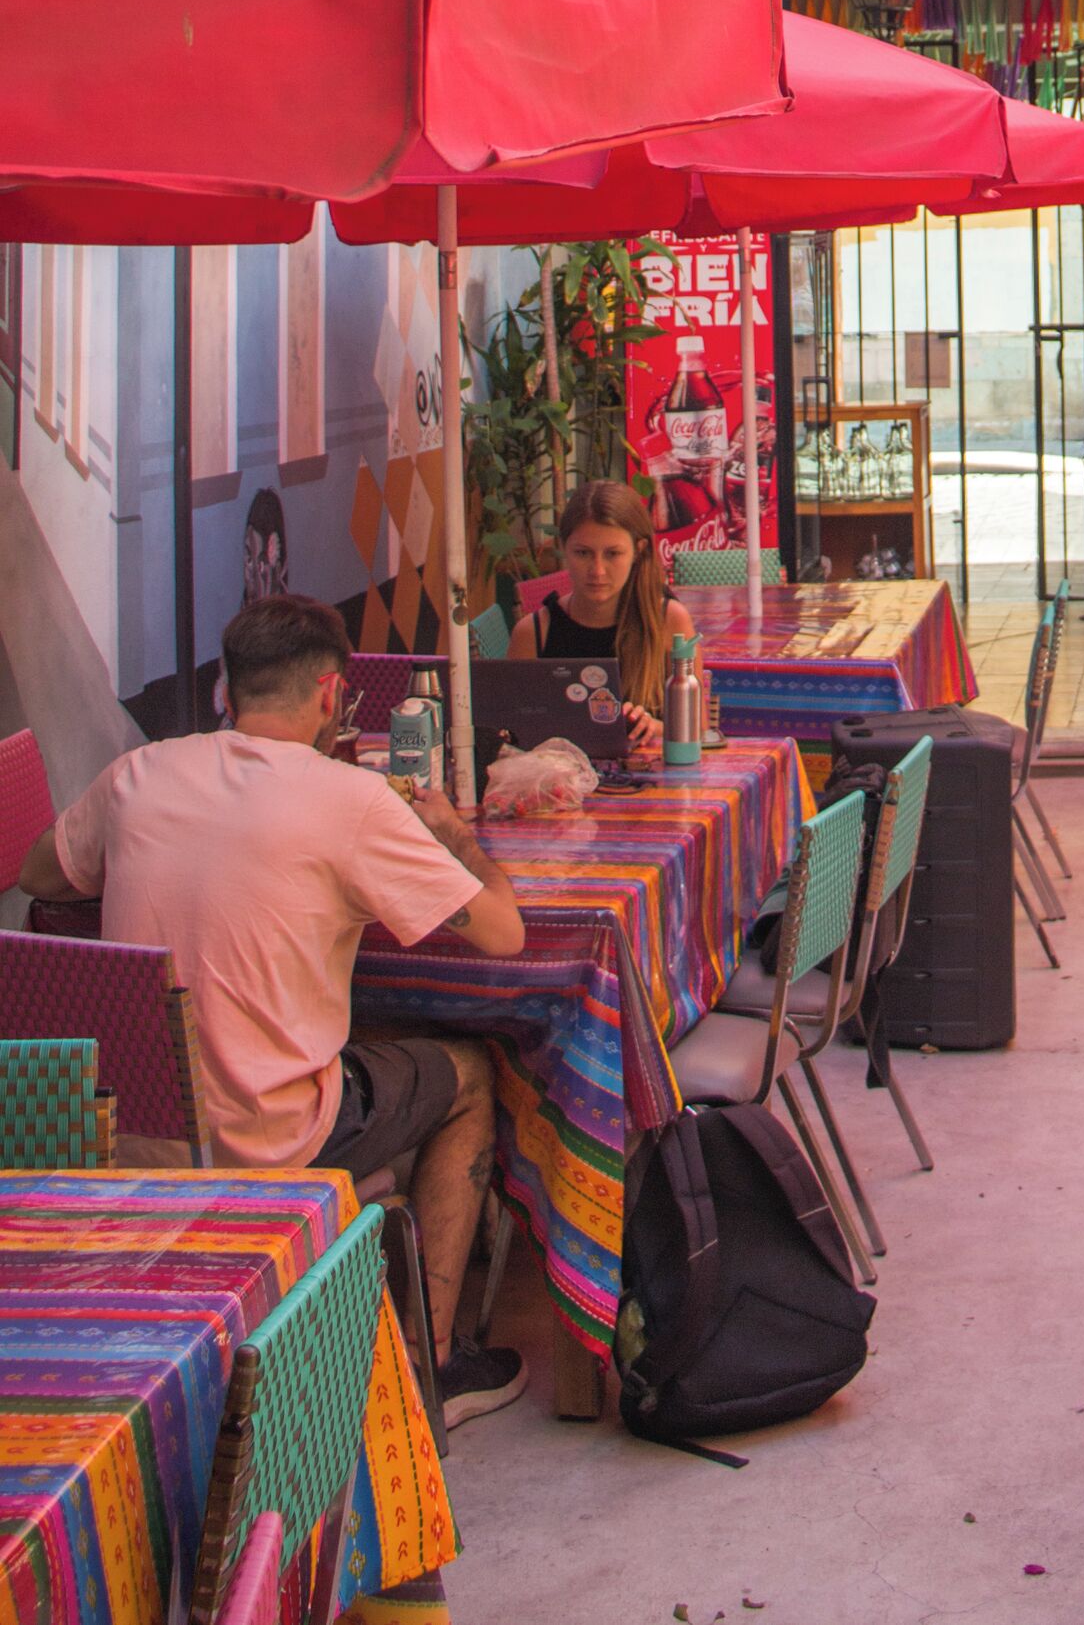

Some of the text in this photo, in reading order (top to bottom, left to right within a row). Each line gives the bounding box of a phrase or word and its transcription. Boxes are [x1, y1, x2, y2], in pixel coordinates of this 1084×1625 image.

[699, 244, 707, 252] Y
[641, 254, 768, 291] BIEN
[641, 292, 769, 327] FRÍA
[392, 732, 427, 748] Seeds
